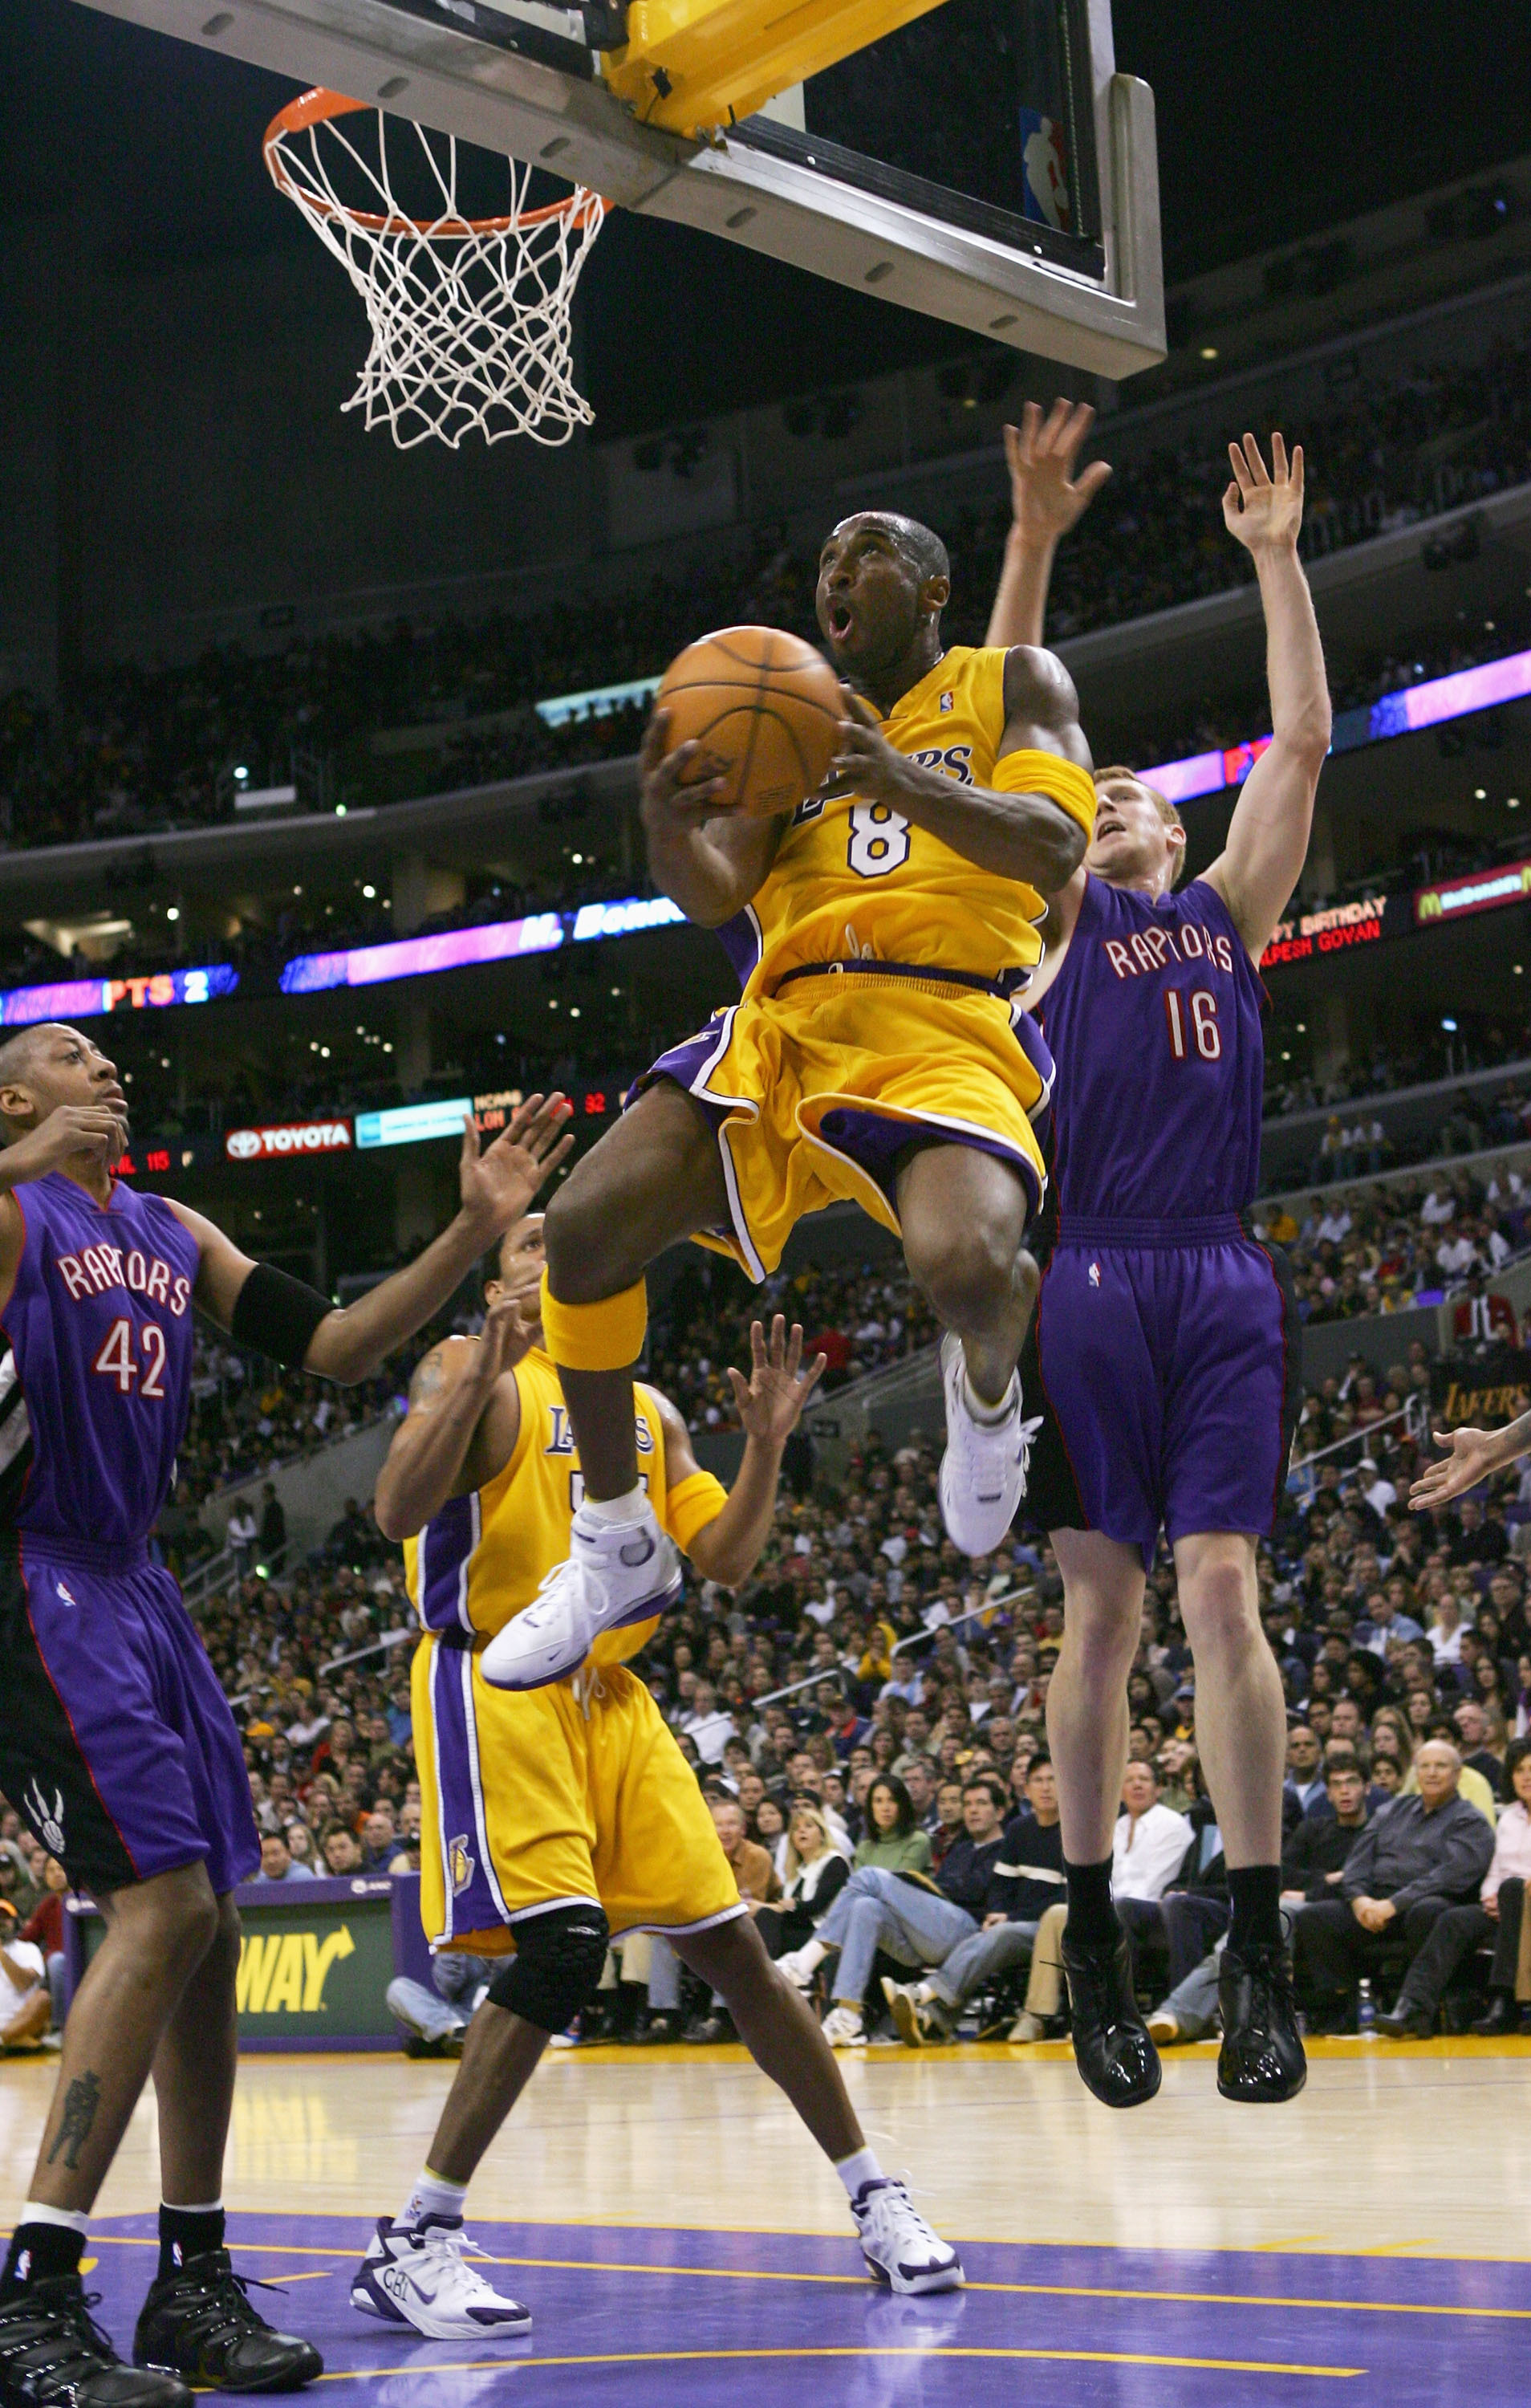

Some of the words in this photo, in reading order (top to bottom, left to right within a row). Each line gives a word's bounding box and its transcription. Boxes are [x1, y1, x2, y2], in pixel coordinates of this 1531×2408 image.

[847, 799, 912, 878] 8
[573, 896, 688, 941] Bonn
[1300, 895, 1387, 937] BIRTHDAY
[1318, 919, 1381, 952] GOVAN
[1101, 922, 1234, 981] RAPTORS
[103, 974, 174, 1011] PTS
[184, 970, 209, 1003] 2
[1163, 986, 1223, 1062] 16
[261, 1124, 351, 1152] TOYOTA
[56, 1242, 192, 1317] RAPTORS
[91, 1315, 169, 1401] 42
[235, 1925, 356, 2014] WAY
